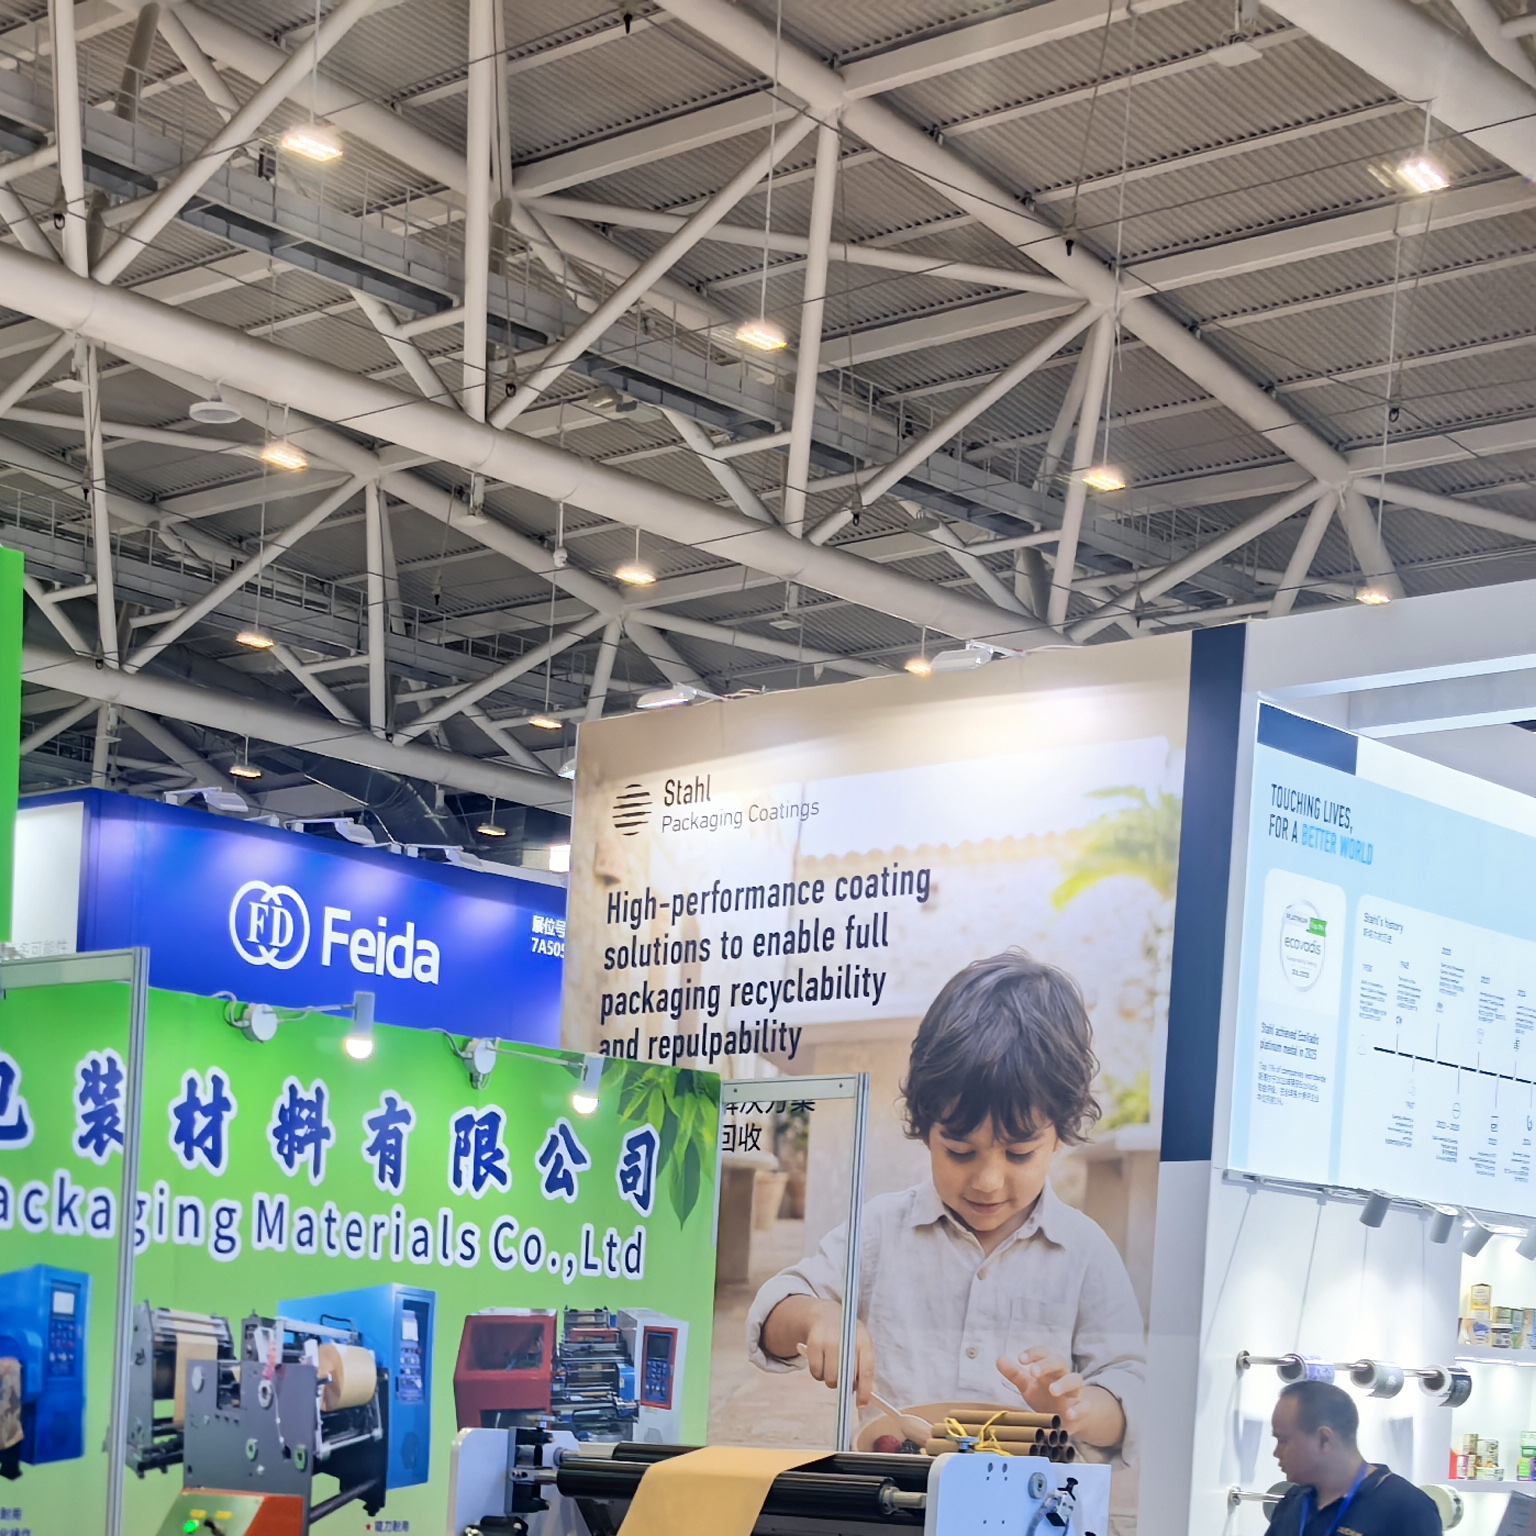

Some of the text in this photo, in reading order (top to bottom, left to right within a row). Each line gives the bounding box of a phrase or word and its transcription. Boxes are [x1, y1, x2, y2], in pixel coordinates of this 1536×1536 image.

[662, 798, 820, 834] Packaging Coatings
[664, 775, 711, 806] Stahl
[1271, 783, 1353, 834] TOUCHING LIVES,
[1269, 813, 1373, 865] FOR A BETTER WORLD
[606, 864, 932, 930] High-performance coating
[247, 901, 294, 945] FD
[322, 907, 441, 985] Feida
[531, 914, 566, 939] 展位号
[604, 912, 888, 971] solutions to enable full
[600, 966, 887, 1025] packaging recyclability
[599, 1018, 803, 1066] and repulpability
[254, 1194, 479, 1263] Materials
[491, 1224, 644, 1280] Co.,Ltd
